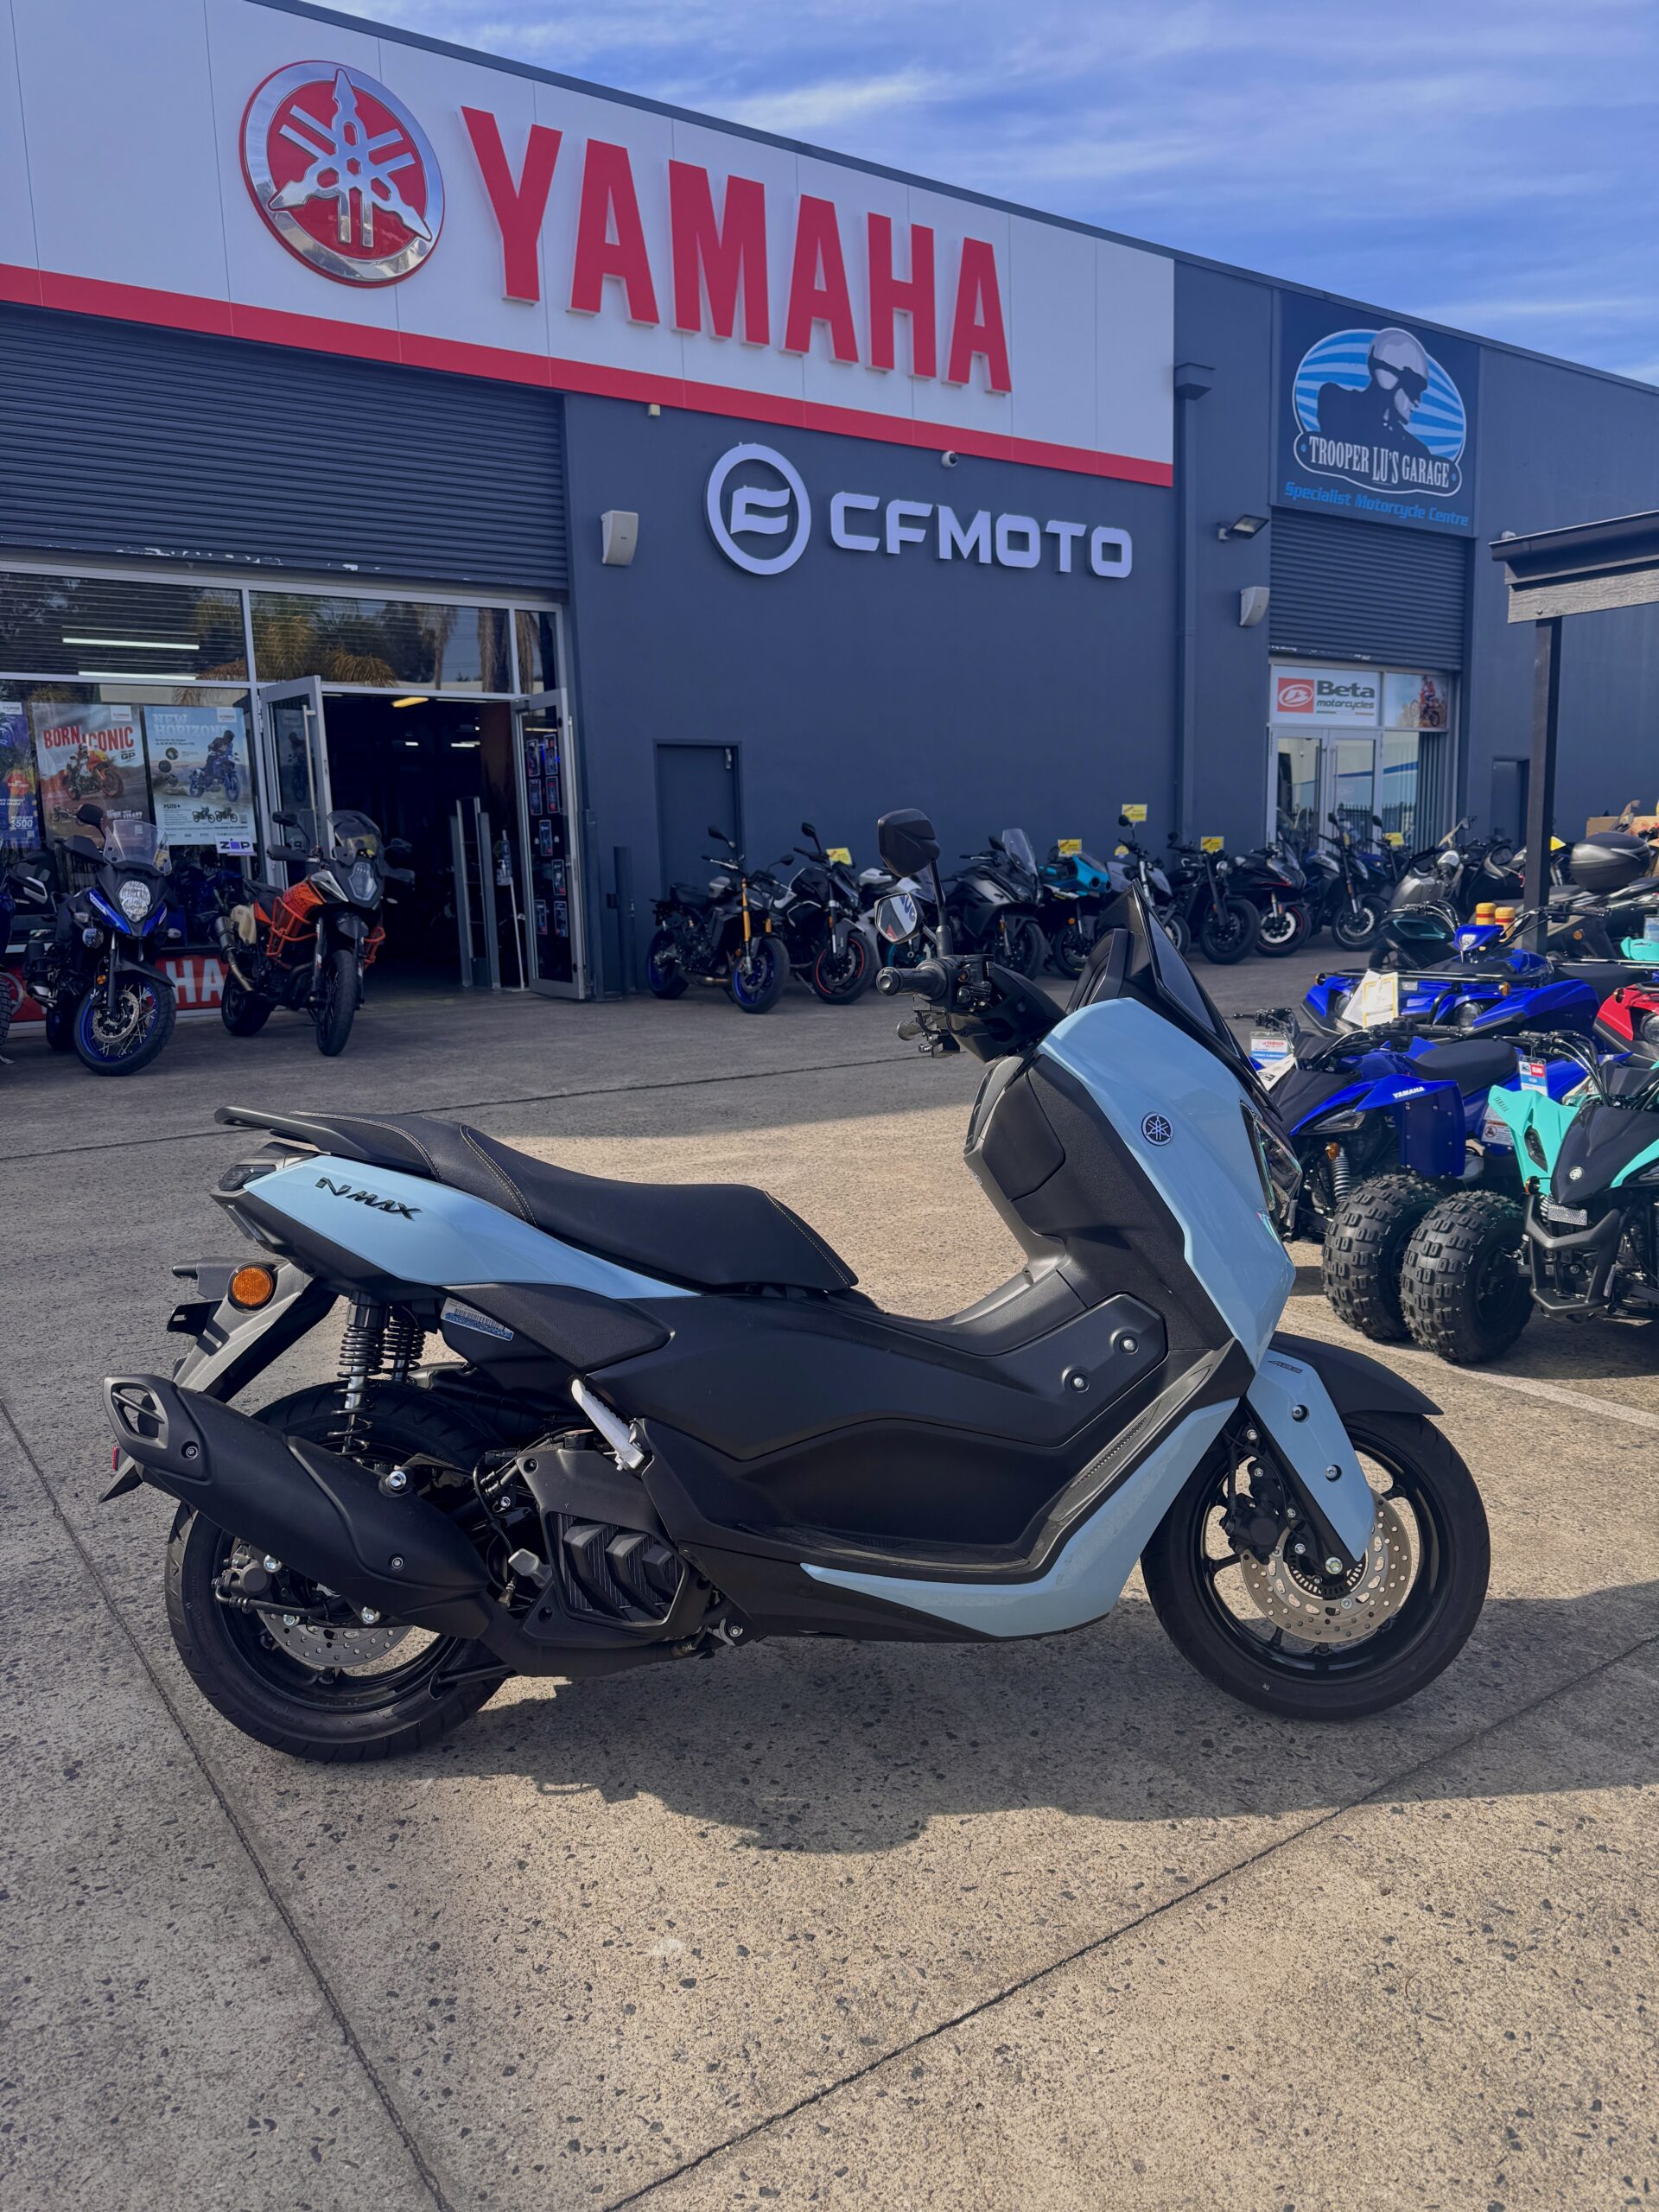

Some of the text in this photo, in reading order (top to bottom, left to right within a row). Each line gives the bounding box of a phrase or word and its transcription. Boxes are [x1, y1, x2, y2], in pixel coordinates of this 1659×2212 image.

[461, 105, 1013, 396] YAMAHA
[1308, 435, 1450, 488] TROOPER LU'S GARAGE
[1284, 480, 1469, 526] Specialist Motorcycle Centre
[830, 489, 1133, 580] CFMOTO
[1316, 679, 1376, 698] Beta
[1316, 699, 1375, 710] motorcycles
[152, 713, 188, 724] NEW
[43, 725, 135, 752] BORN ICONIC
[120, 752, 136, 760] GP
[1392, 1086, 1425, 1099] YAMAHA
[315, 1176, 422, 1222] NMAX
